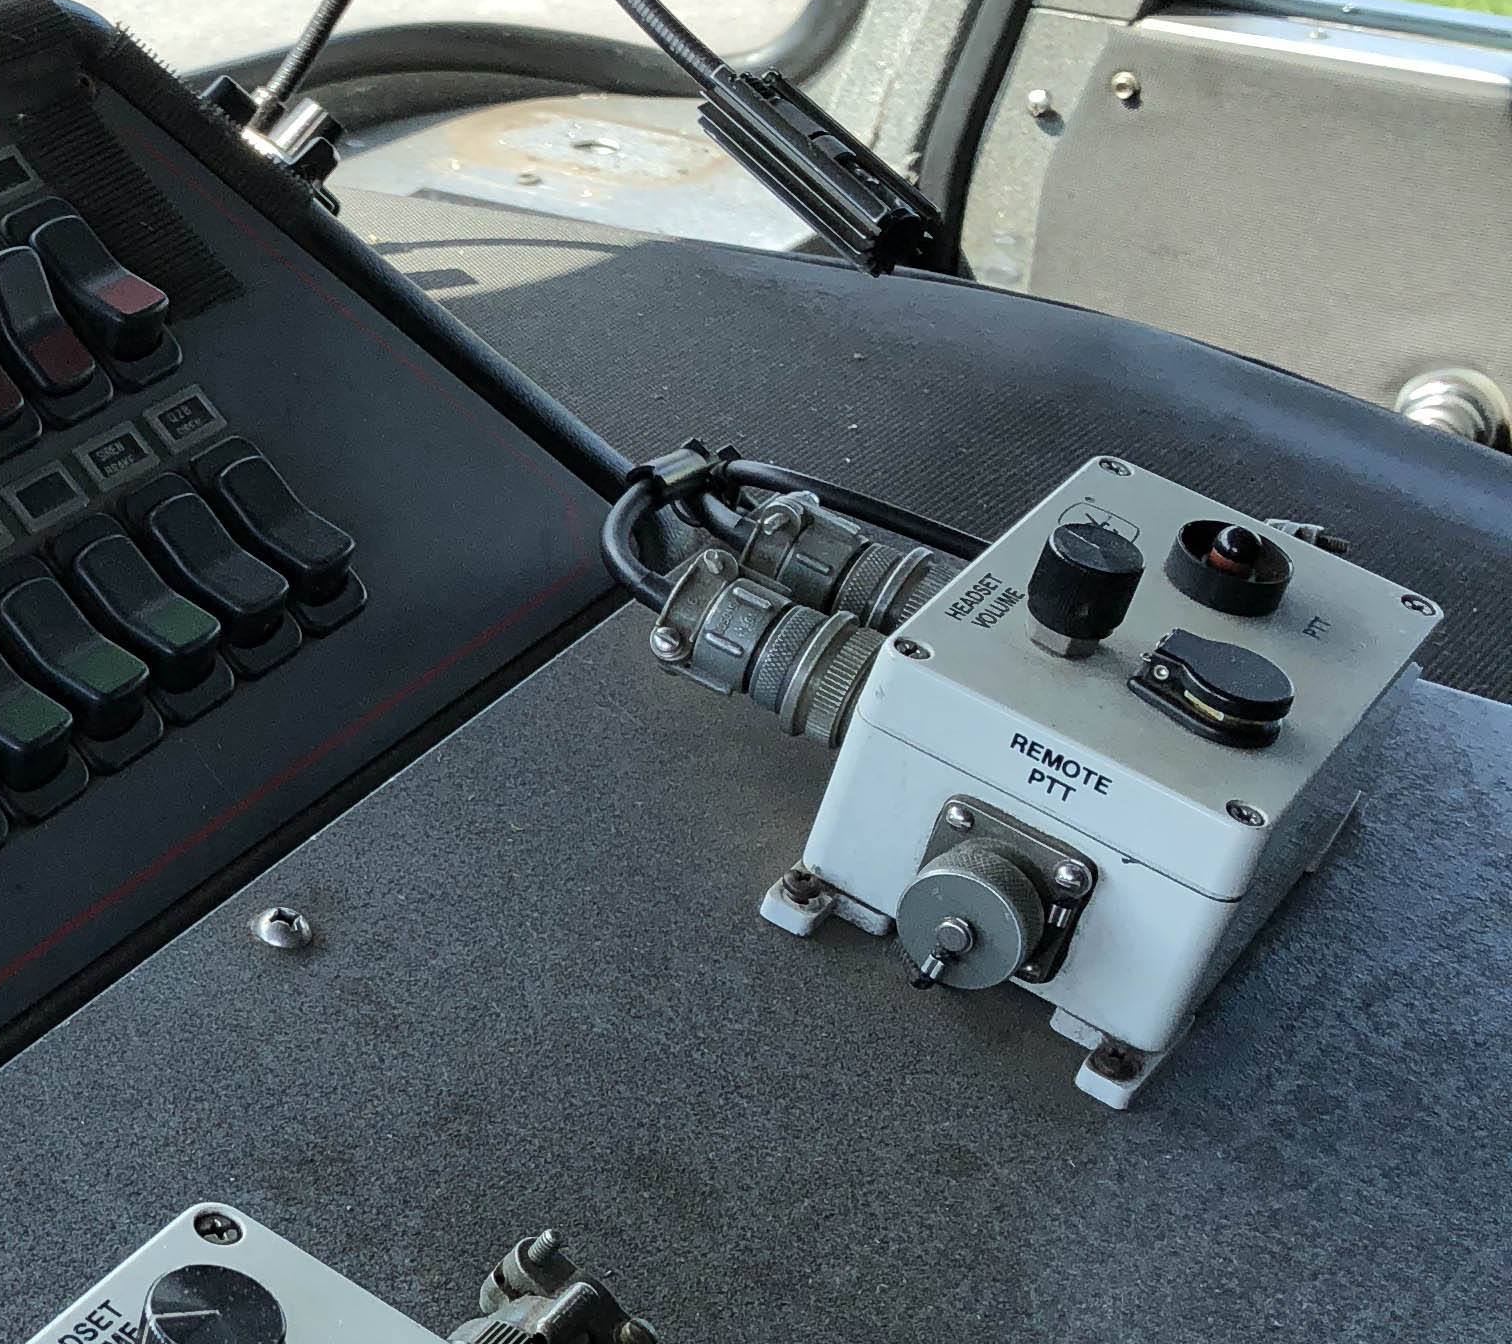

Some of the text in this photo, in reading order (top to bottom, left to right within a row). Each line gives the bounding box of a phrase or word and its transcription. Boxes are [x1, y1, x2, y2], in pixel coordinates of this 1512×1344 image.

[944, 572, 1004, 621] HEADSET
[971, 587, 1026, 629] VOLUME
[1301, 615, 1332, 641] PTT
[1010, 732, 1113, 796] REMOTE
[1027, 767, 1077, 802] PTT
